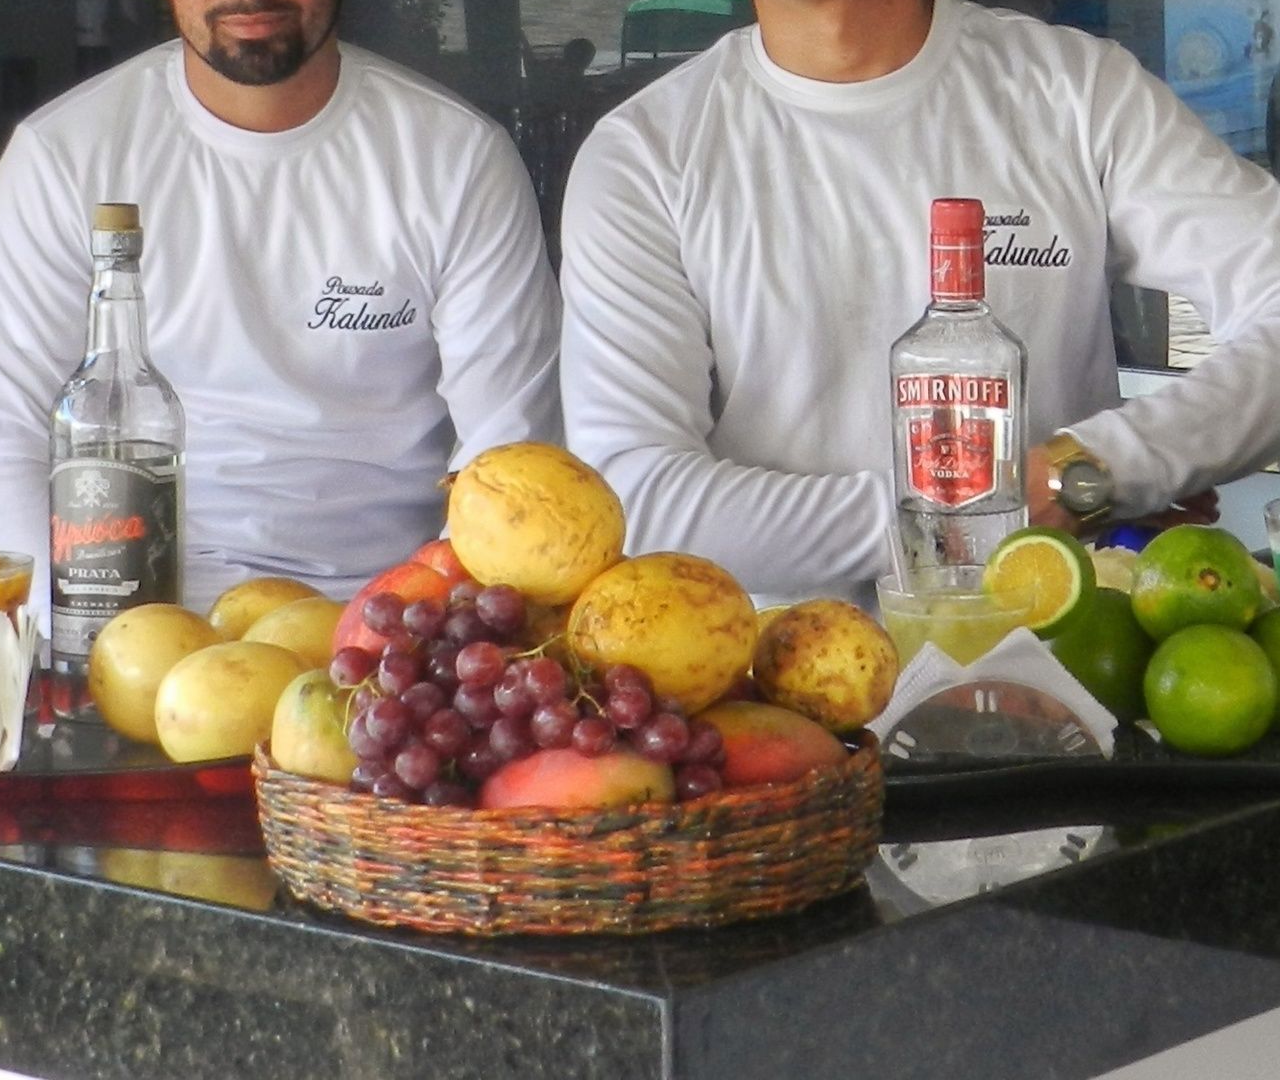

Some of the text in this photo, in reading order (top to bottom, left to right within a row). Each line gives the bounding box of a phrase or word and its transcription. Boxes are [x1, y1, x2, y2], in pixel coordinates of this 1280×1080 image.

[983, 209, 1031, 227] ousada
[323, 276, 384, 296] Pousada
[308, 297, 417, 330] Kalunda
[899, 378, 1004, 403] SMIRNOFF
[929, 469, 970, 479] VODKA
[68, 567, 121, 579] PRATA
